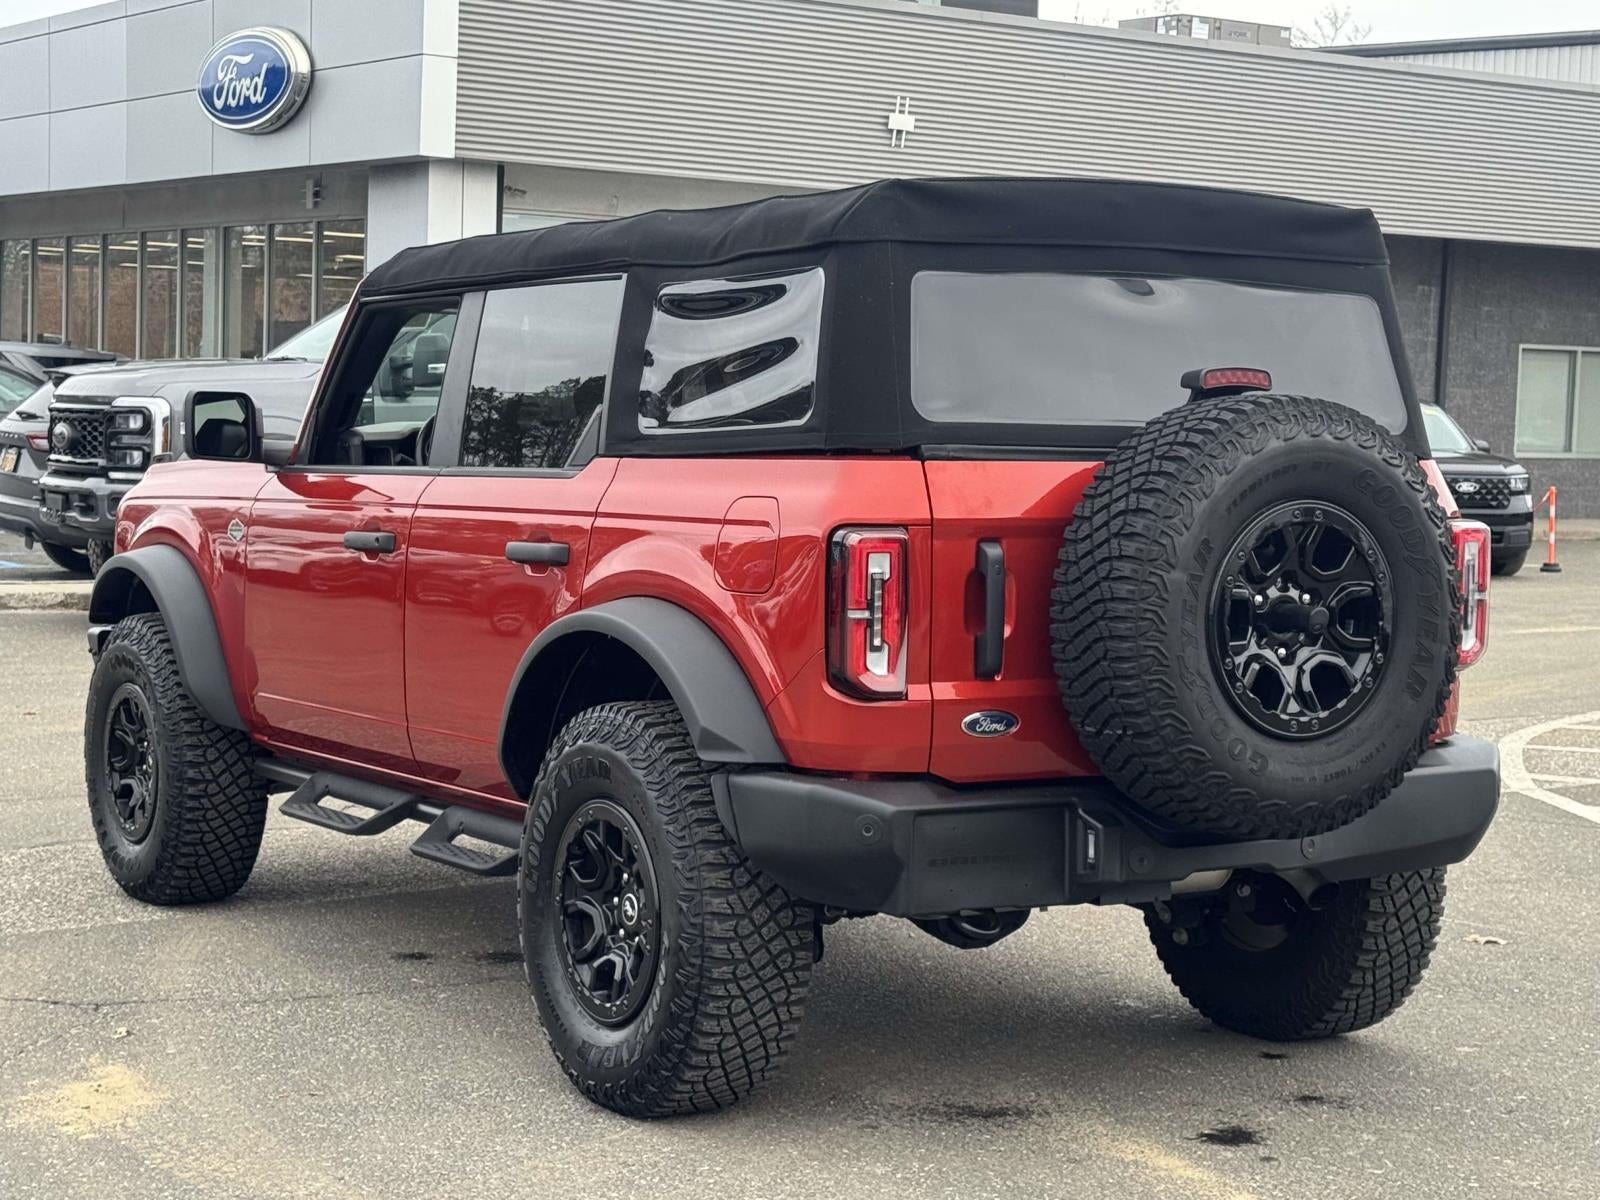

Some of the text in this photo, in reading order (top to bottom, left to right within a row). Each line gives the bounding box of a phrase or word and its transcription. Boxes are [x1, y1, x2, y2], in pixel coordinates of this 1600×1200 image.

[213, 53, 269, 110] Ford
[1353, 467, 1443, 702] GOODYEAR
[976, 716, 1007, 732] Ford
[1178, 536, 1269, 776] GOODYEAR
[525, 756, 613, 893] GOODYEAR
